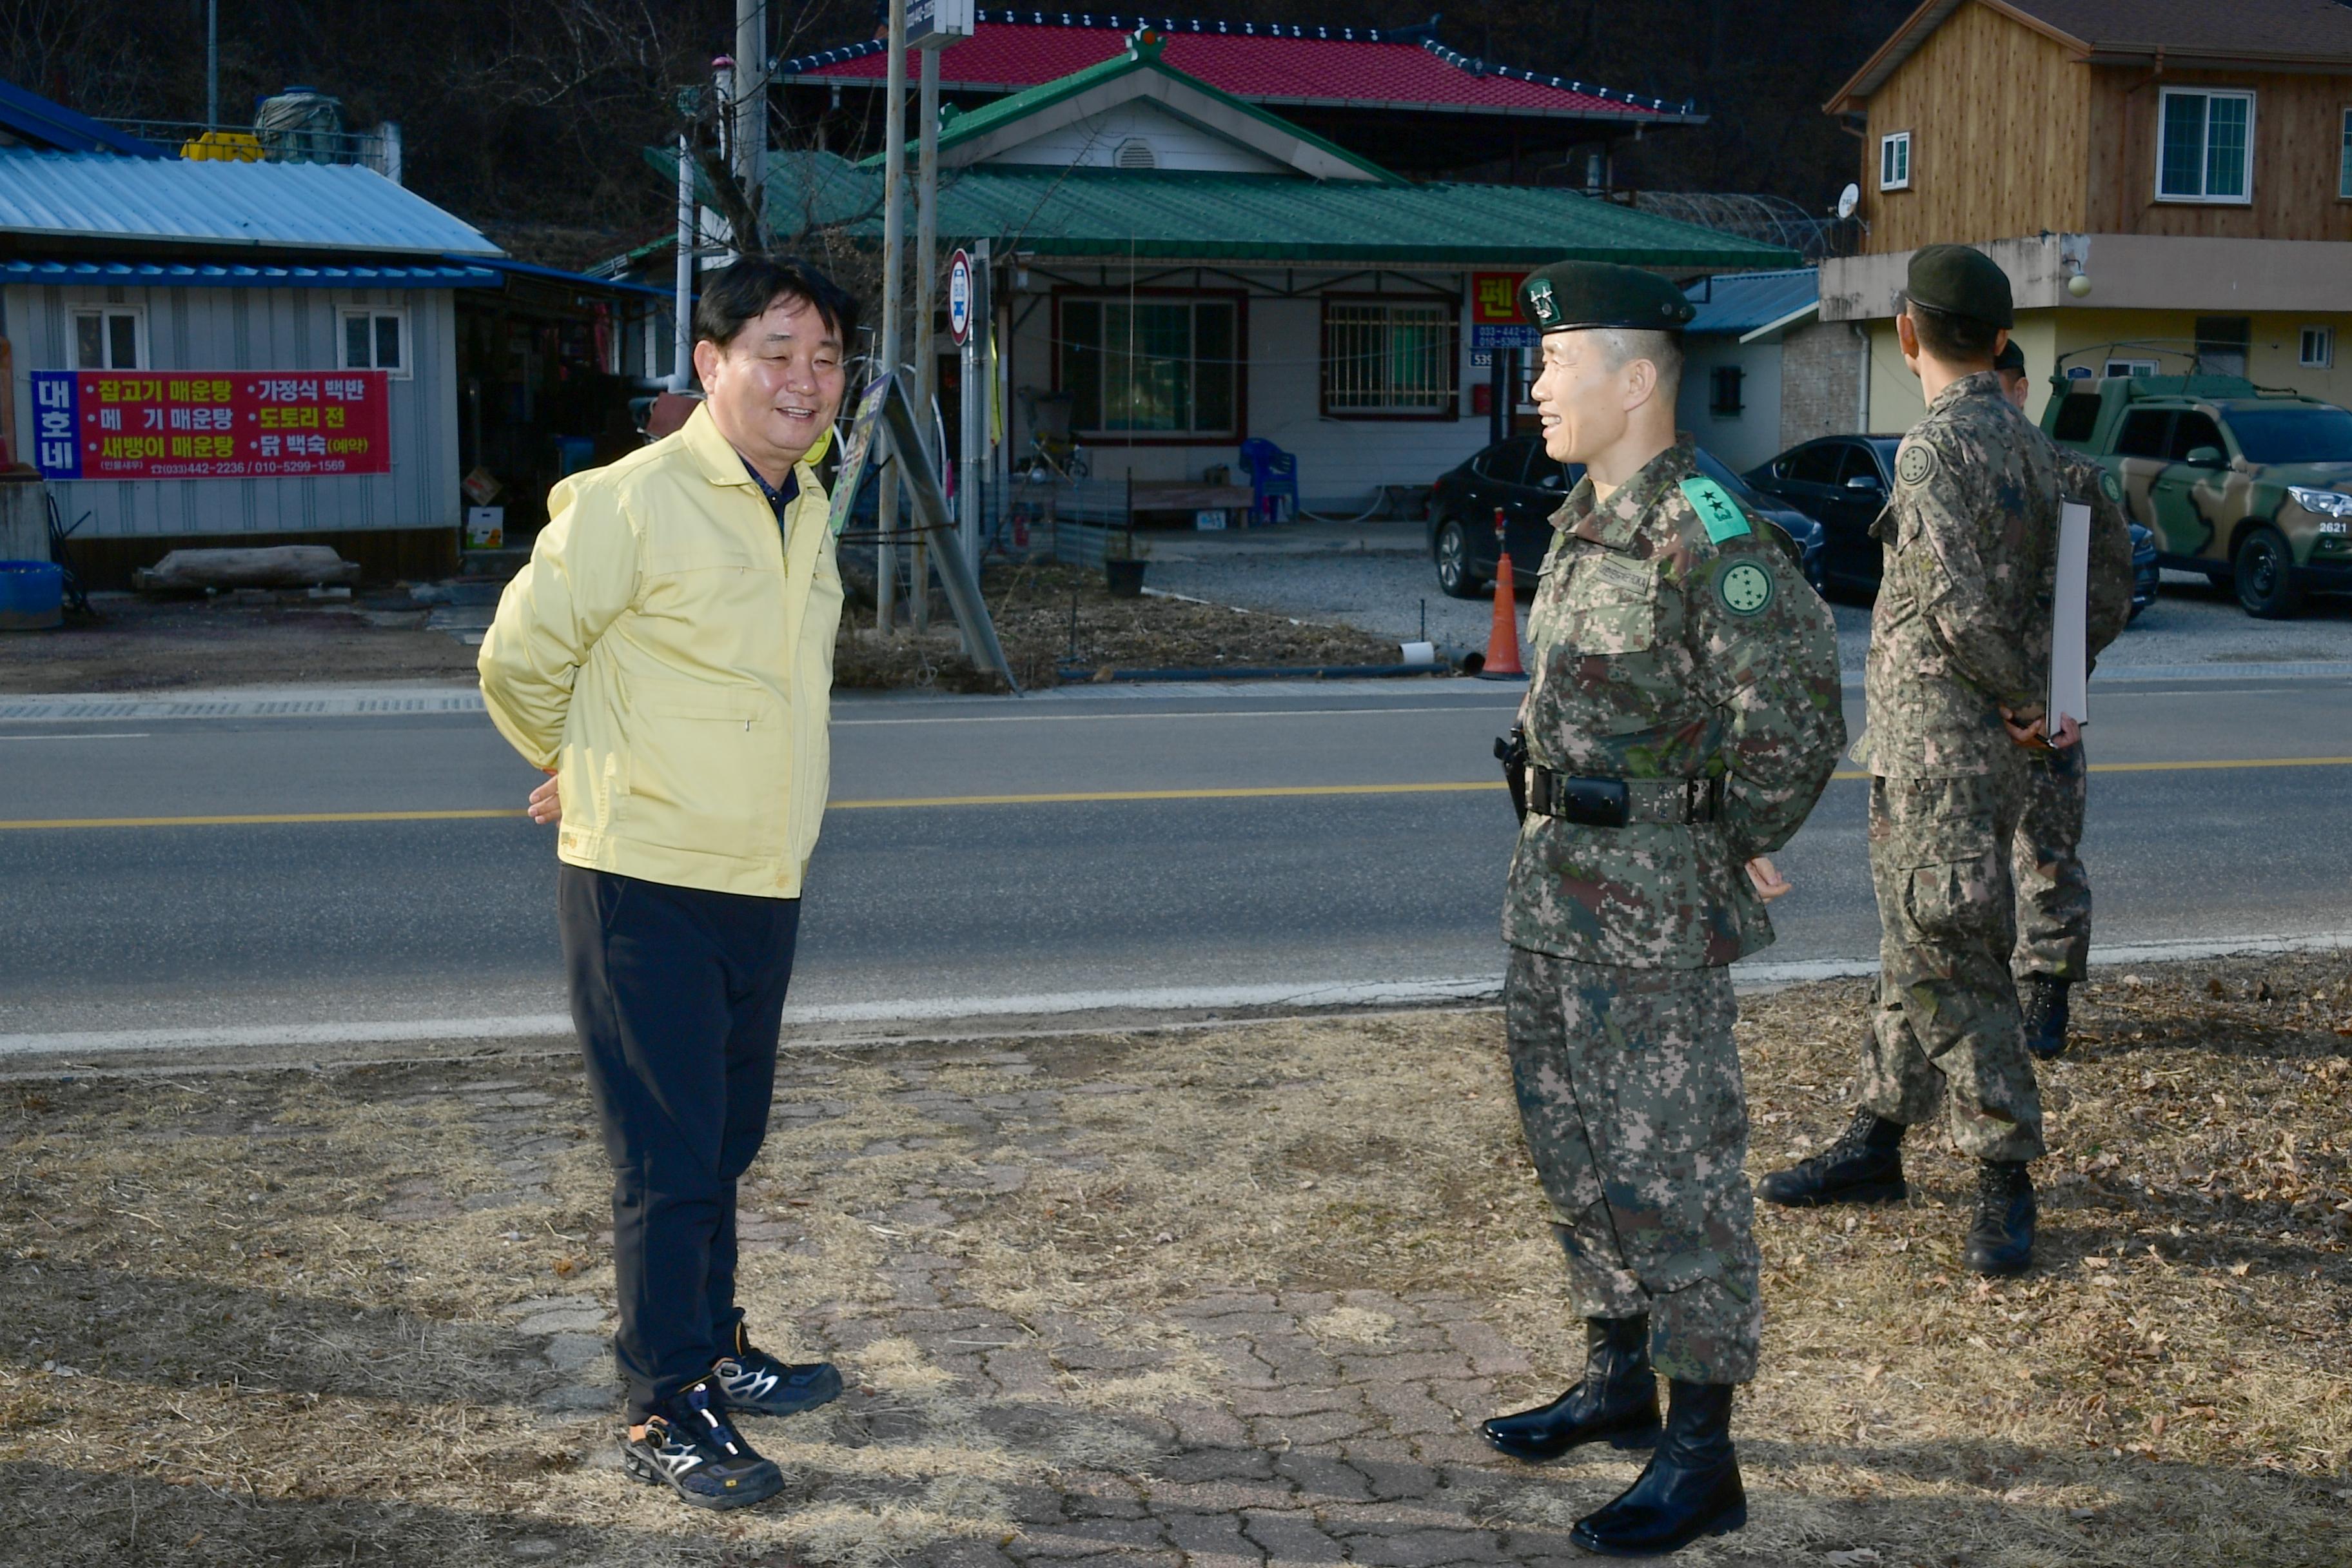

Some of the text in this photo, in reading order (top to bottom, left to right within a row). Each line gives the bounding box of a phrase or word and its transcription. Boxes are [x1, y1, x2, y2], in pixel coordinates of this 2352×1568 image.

[1479, 278, 1513, 317] 펜
[99, 380, 231, 402] 잡고기 매운탕
[259, 380, 364, 402] 가정식 백반
[38, 380, 72, 469] 대호네
[171, 409, 233, 429] 매운탕
[260, 407, 344, 427] 도토리 전
[102, 436, 233, 458] 새뱅이 매운탕
[261, 436, 280, 456] 닭
[255, 460, 345, 474] 010-5299-1569
[2319, 523, 2346, 533] 2621
